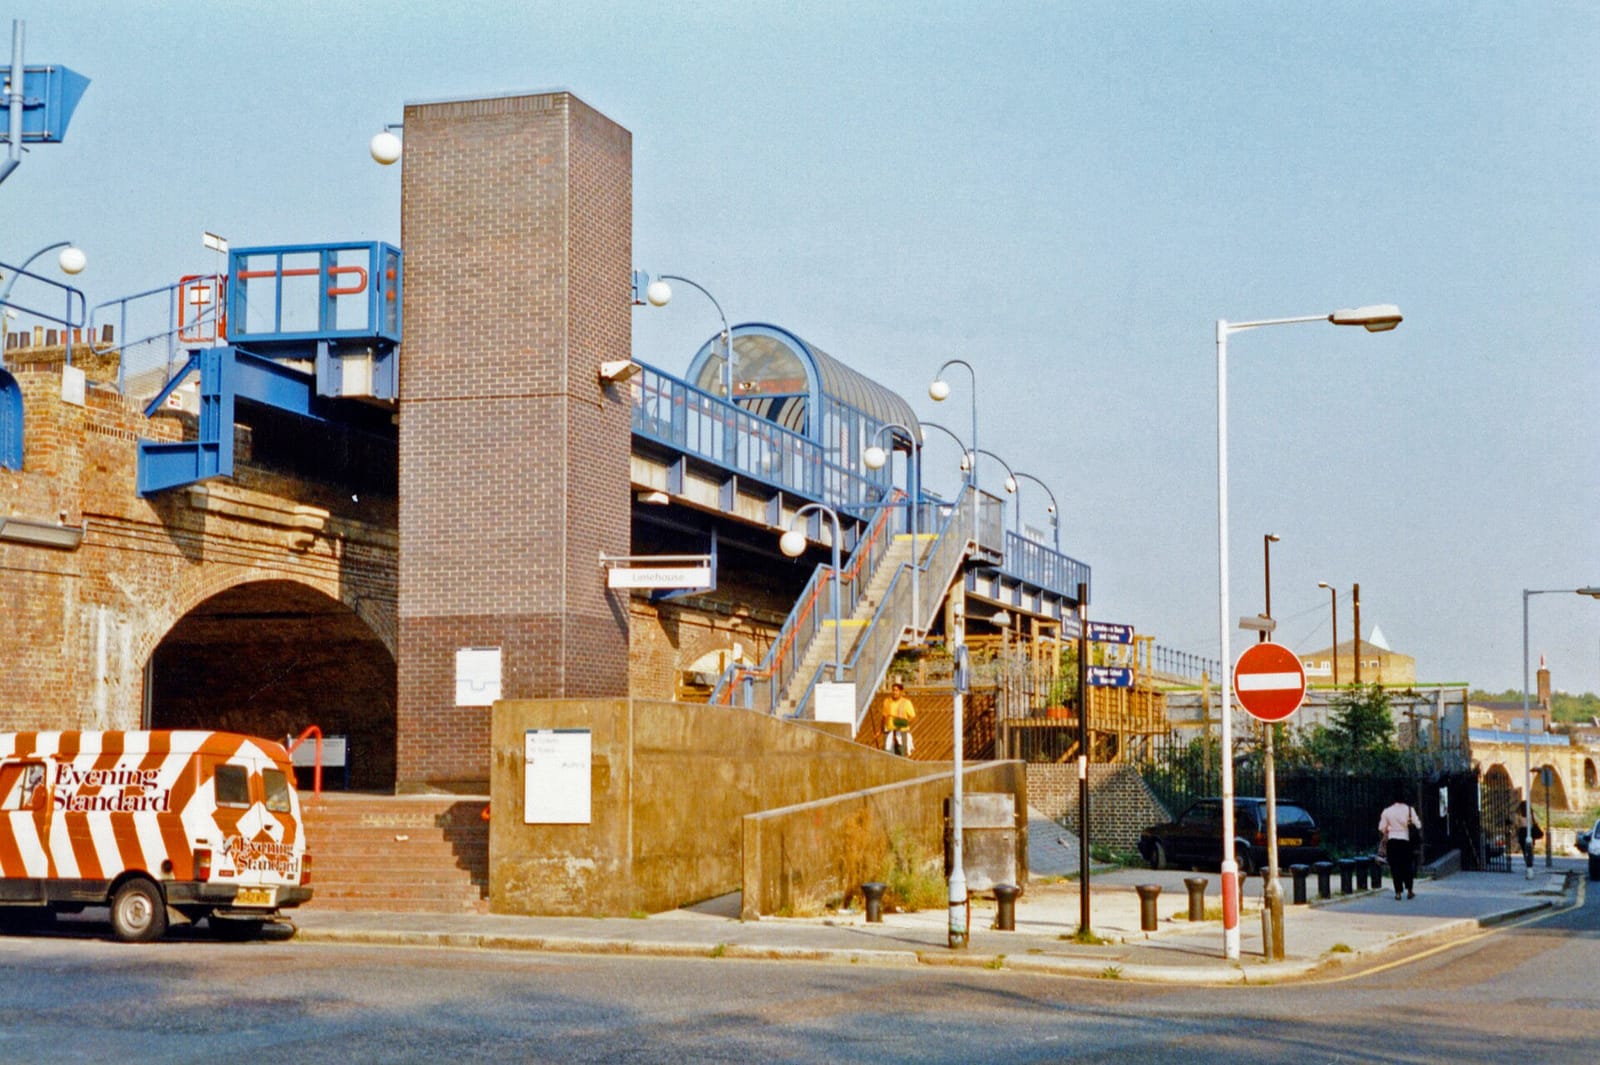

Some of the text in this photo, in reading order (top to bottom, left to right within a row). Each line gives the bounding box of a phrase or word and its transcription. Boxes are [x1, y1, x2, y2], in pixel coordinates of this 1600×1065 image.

[632, 572, 685, 583] Limehouse
[55, 763, 162, 790] Evening
[54, 789, 170, 812] Standard
[240, 837, 294, 857] Evening
[238, 855, 299, 873] Standard
